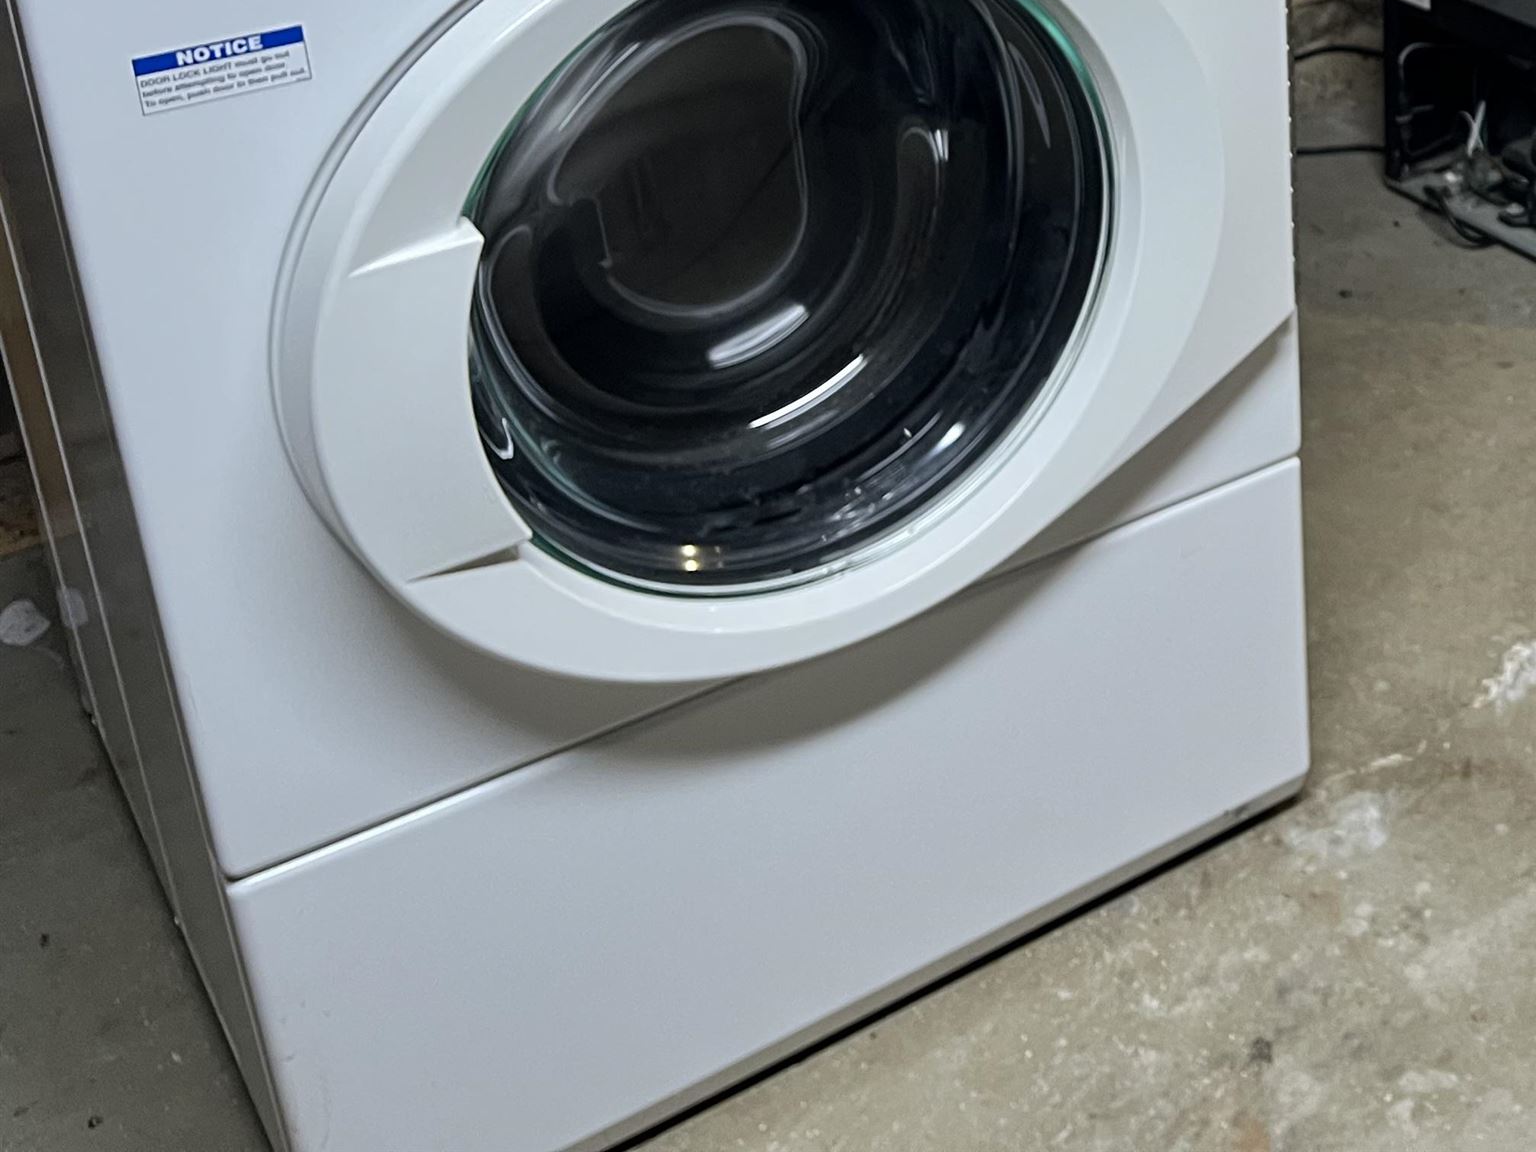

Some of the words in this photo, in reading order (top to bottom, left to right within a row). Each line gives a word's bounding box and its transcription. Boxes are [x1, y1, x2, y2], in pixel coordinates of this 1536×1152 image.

[176, 35, 264, 66] NOTICE
[141, 75, 170, 88] DOOR
[173, 70, 200, 81] LOCK
[203, 62, 232, 75] LIGHT
